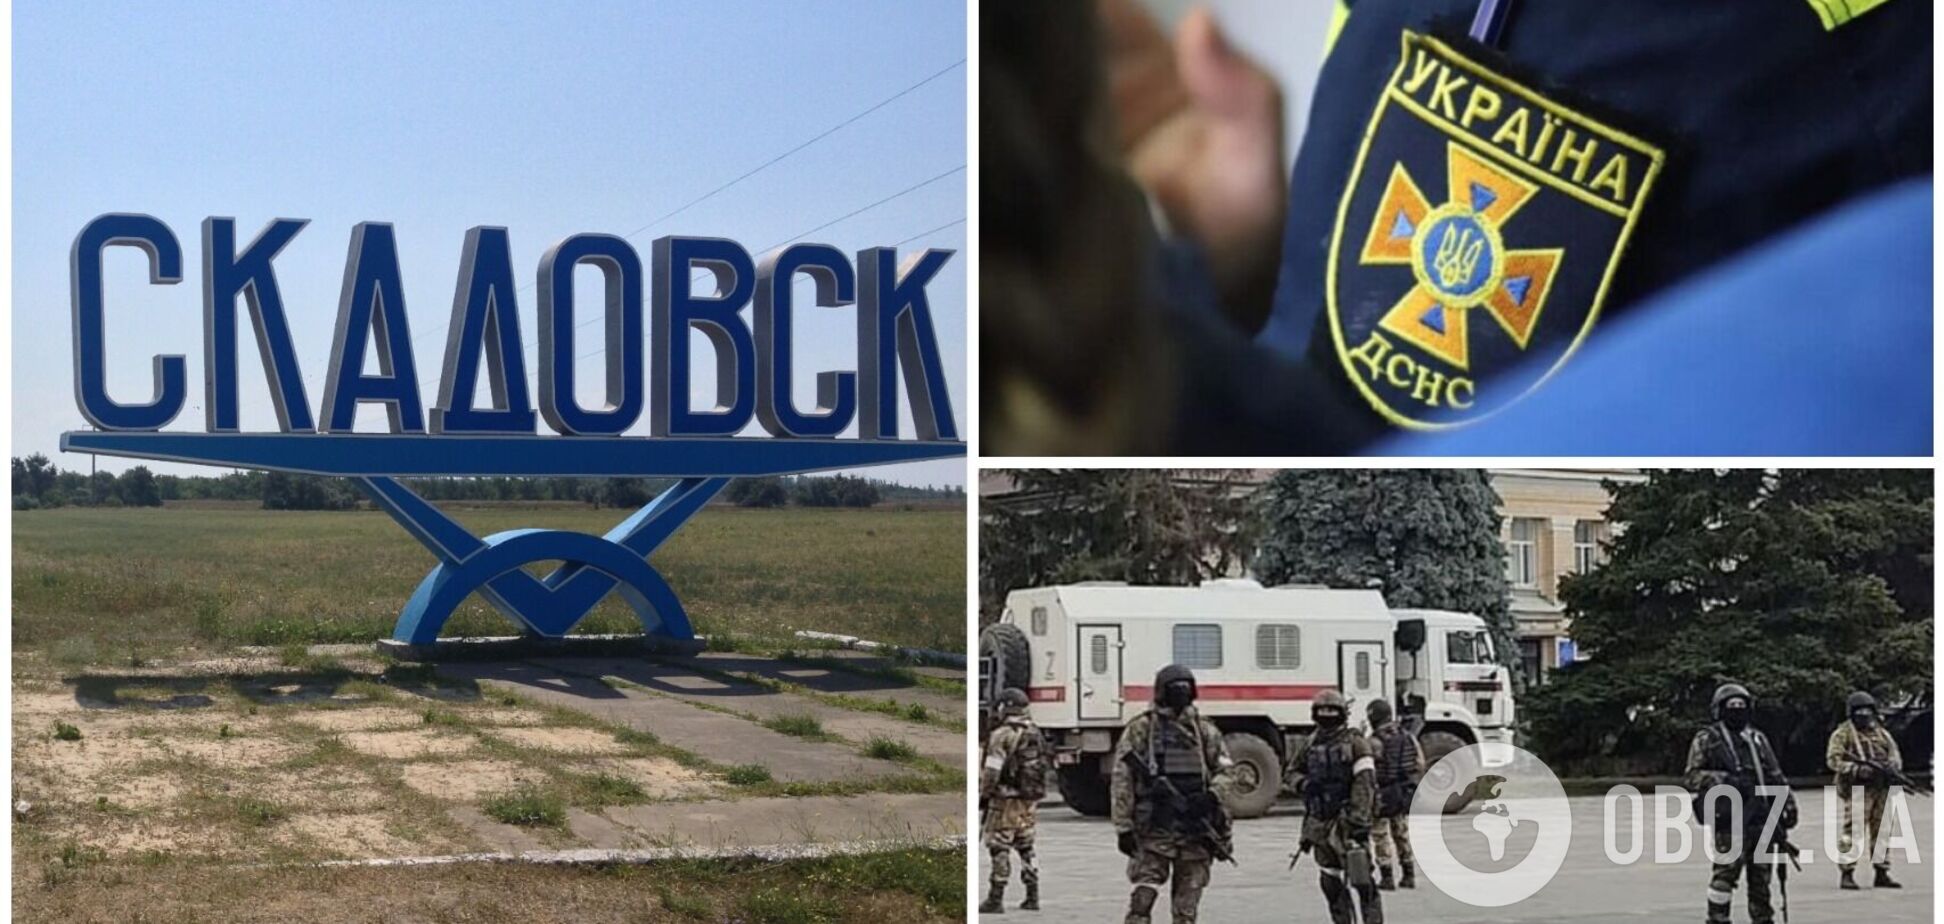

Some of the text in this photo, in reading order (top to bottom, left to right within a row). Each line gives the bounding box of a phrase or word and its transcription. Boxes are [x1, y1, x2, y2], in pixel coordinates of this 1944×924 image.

[1403, 50, 1629, 200] УКРАЇНА
[70, 212, 957, 440] СКАДОВСК
[1350, 331, 1475, 409] ДСНС
